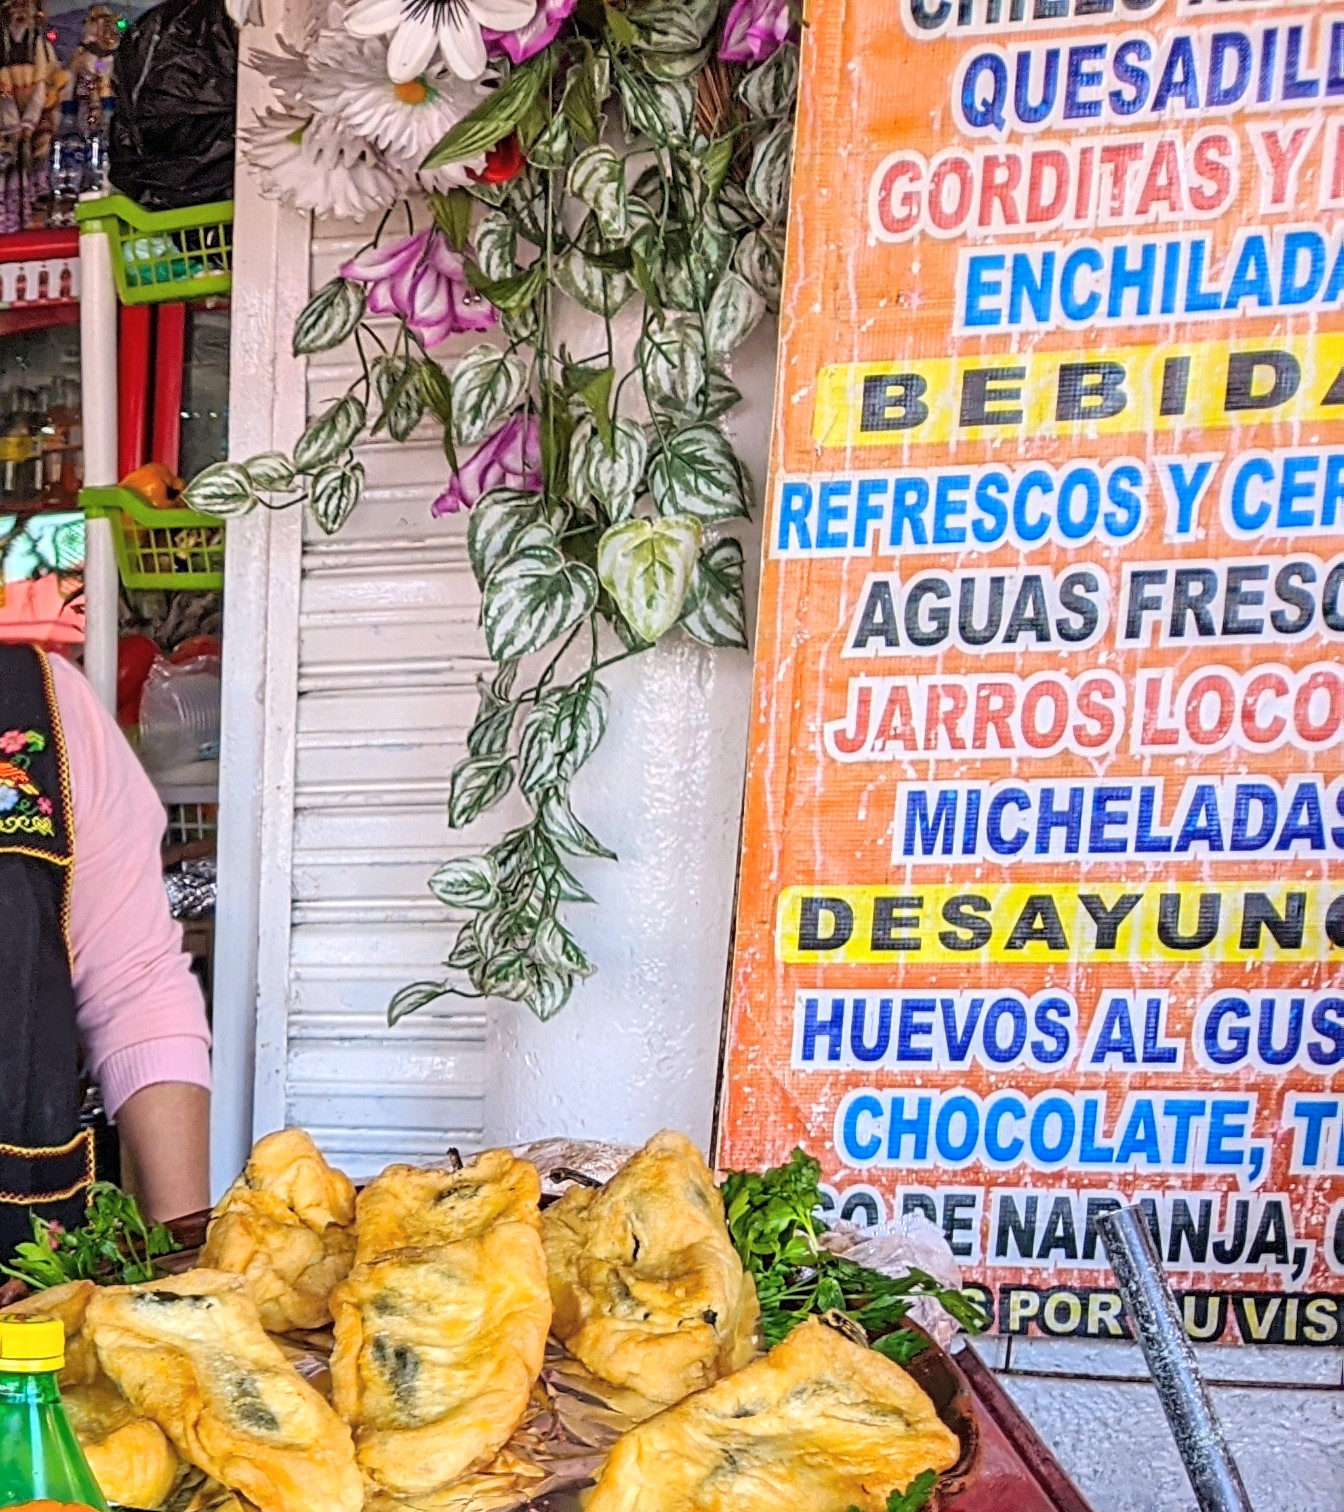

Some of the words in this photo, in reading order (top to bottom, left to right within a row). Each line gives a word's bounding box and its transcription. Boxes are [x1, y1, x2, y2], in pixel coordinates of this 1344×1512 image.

[878, 135, 1234, 234] GORDITAS
[1260, 127, 1312, 205] Y
[778, 466, 1144, 550] REFRESCOS
[1171, 462, 1212, 535] Y
[852, 570, 1099, 649] AGUAS
[833, 678, 1116, 754] JARROS
[1140, 671, 1344, 747] LOCO
[801, 997, 1071, 1065] HUEVOS
[1090, 998, 1176, 1064] AL
[1204, 997, 1344, 1066] GUS
[843, 1094, 1264, 1182] CHOCOLATE,
[1295, 1101, 1344, 1166] T
[1010, 1293, 1123, 1336] POR
[1242, 1297, 1338, 1341] VIS
